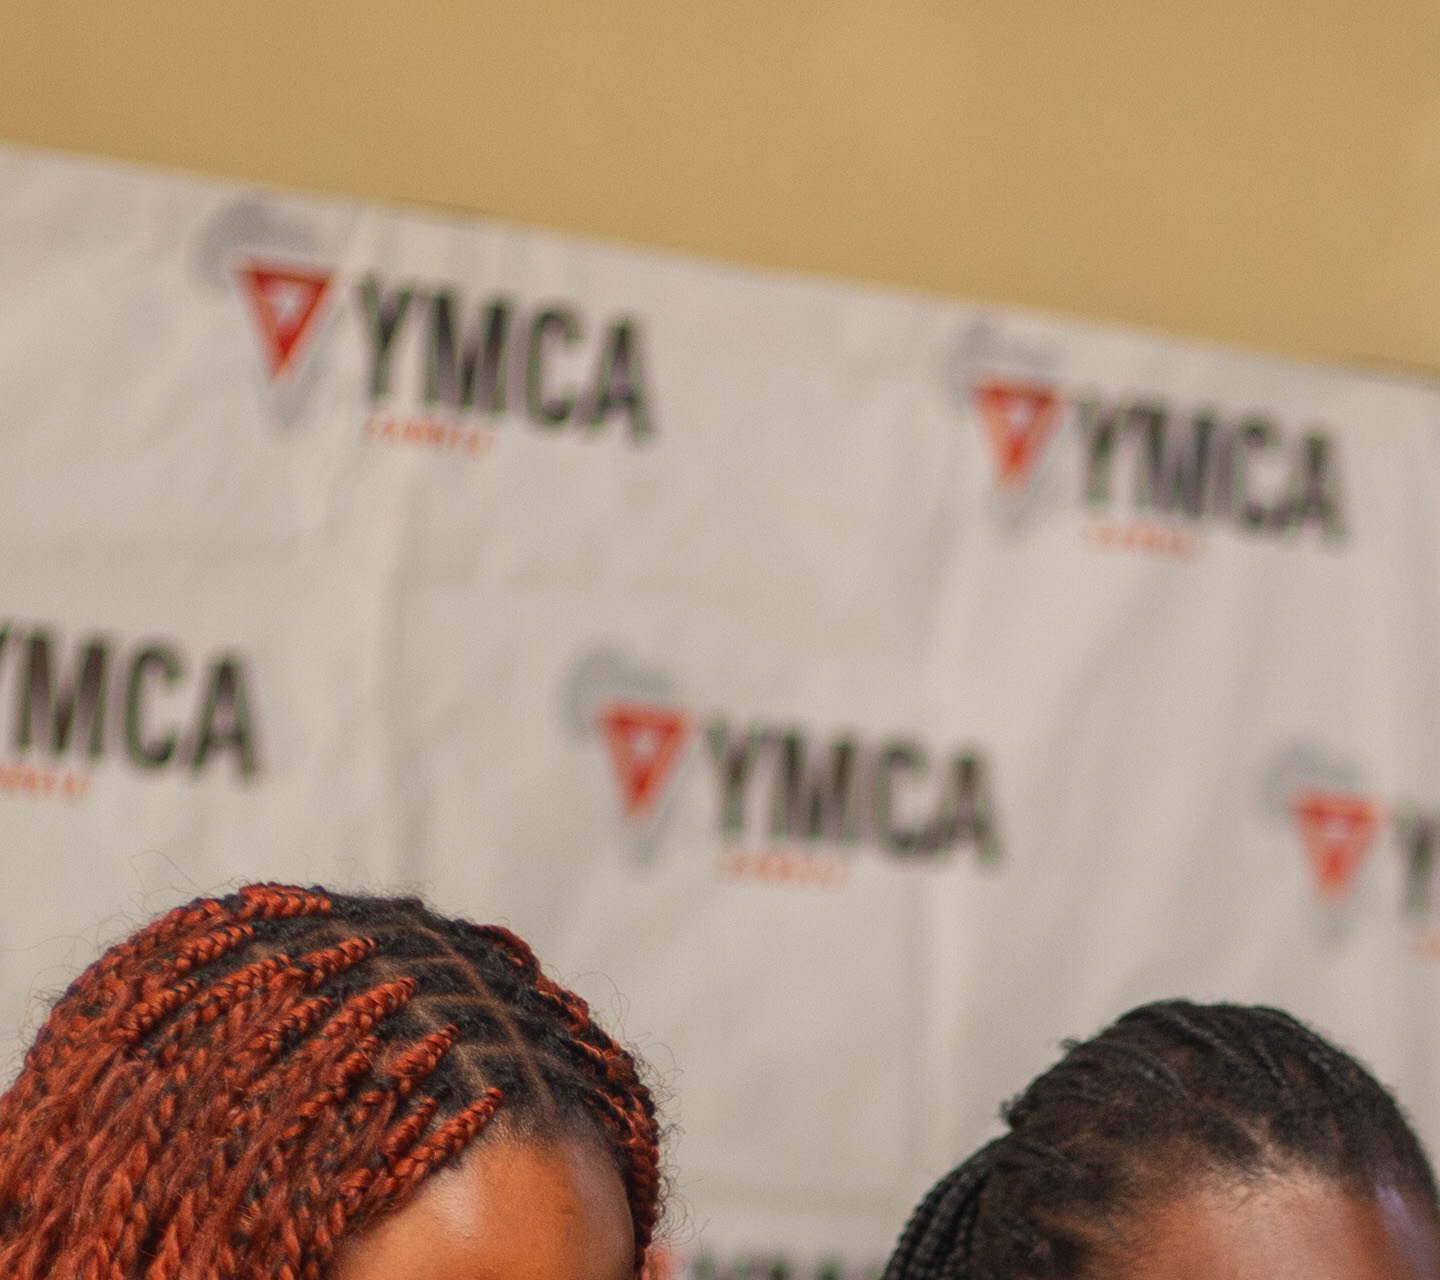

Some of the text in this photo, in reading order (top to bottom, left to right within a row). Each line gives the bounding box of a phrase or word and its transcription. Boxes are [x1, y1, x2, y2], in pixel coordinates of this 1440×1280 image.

[357, 274, 658, 447] YMCA
[1077, 396, 1346, 547] YMCA
[707, 715, 1006, 868] YMCA
